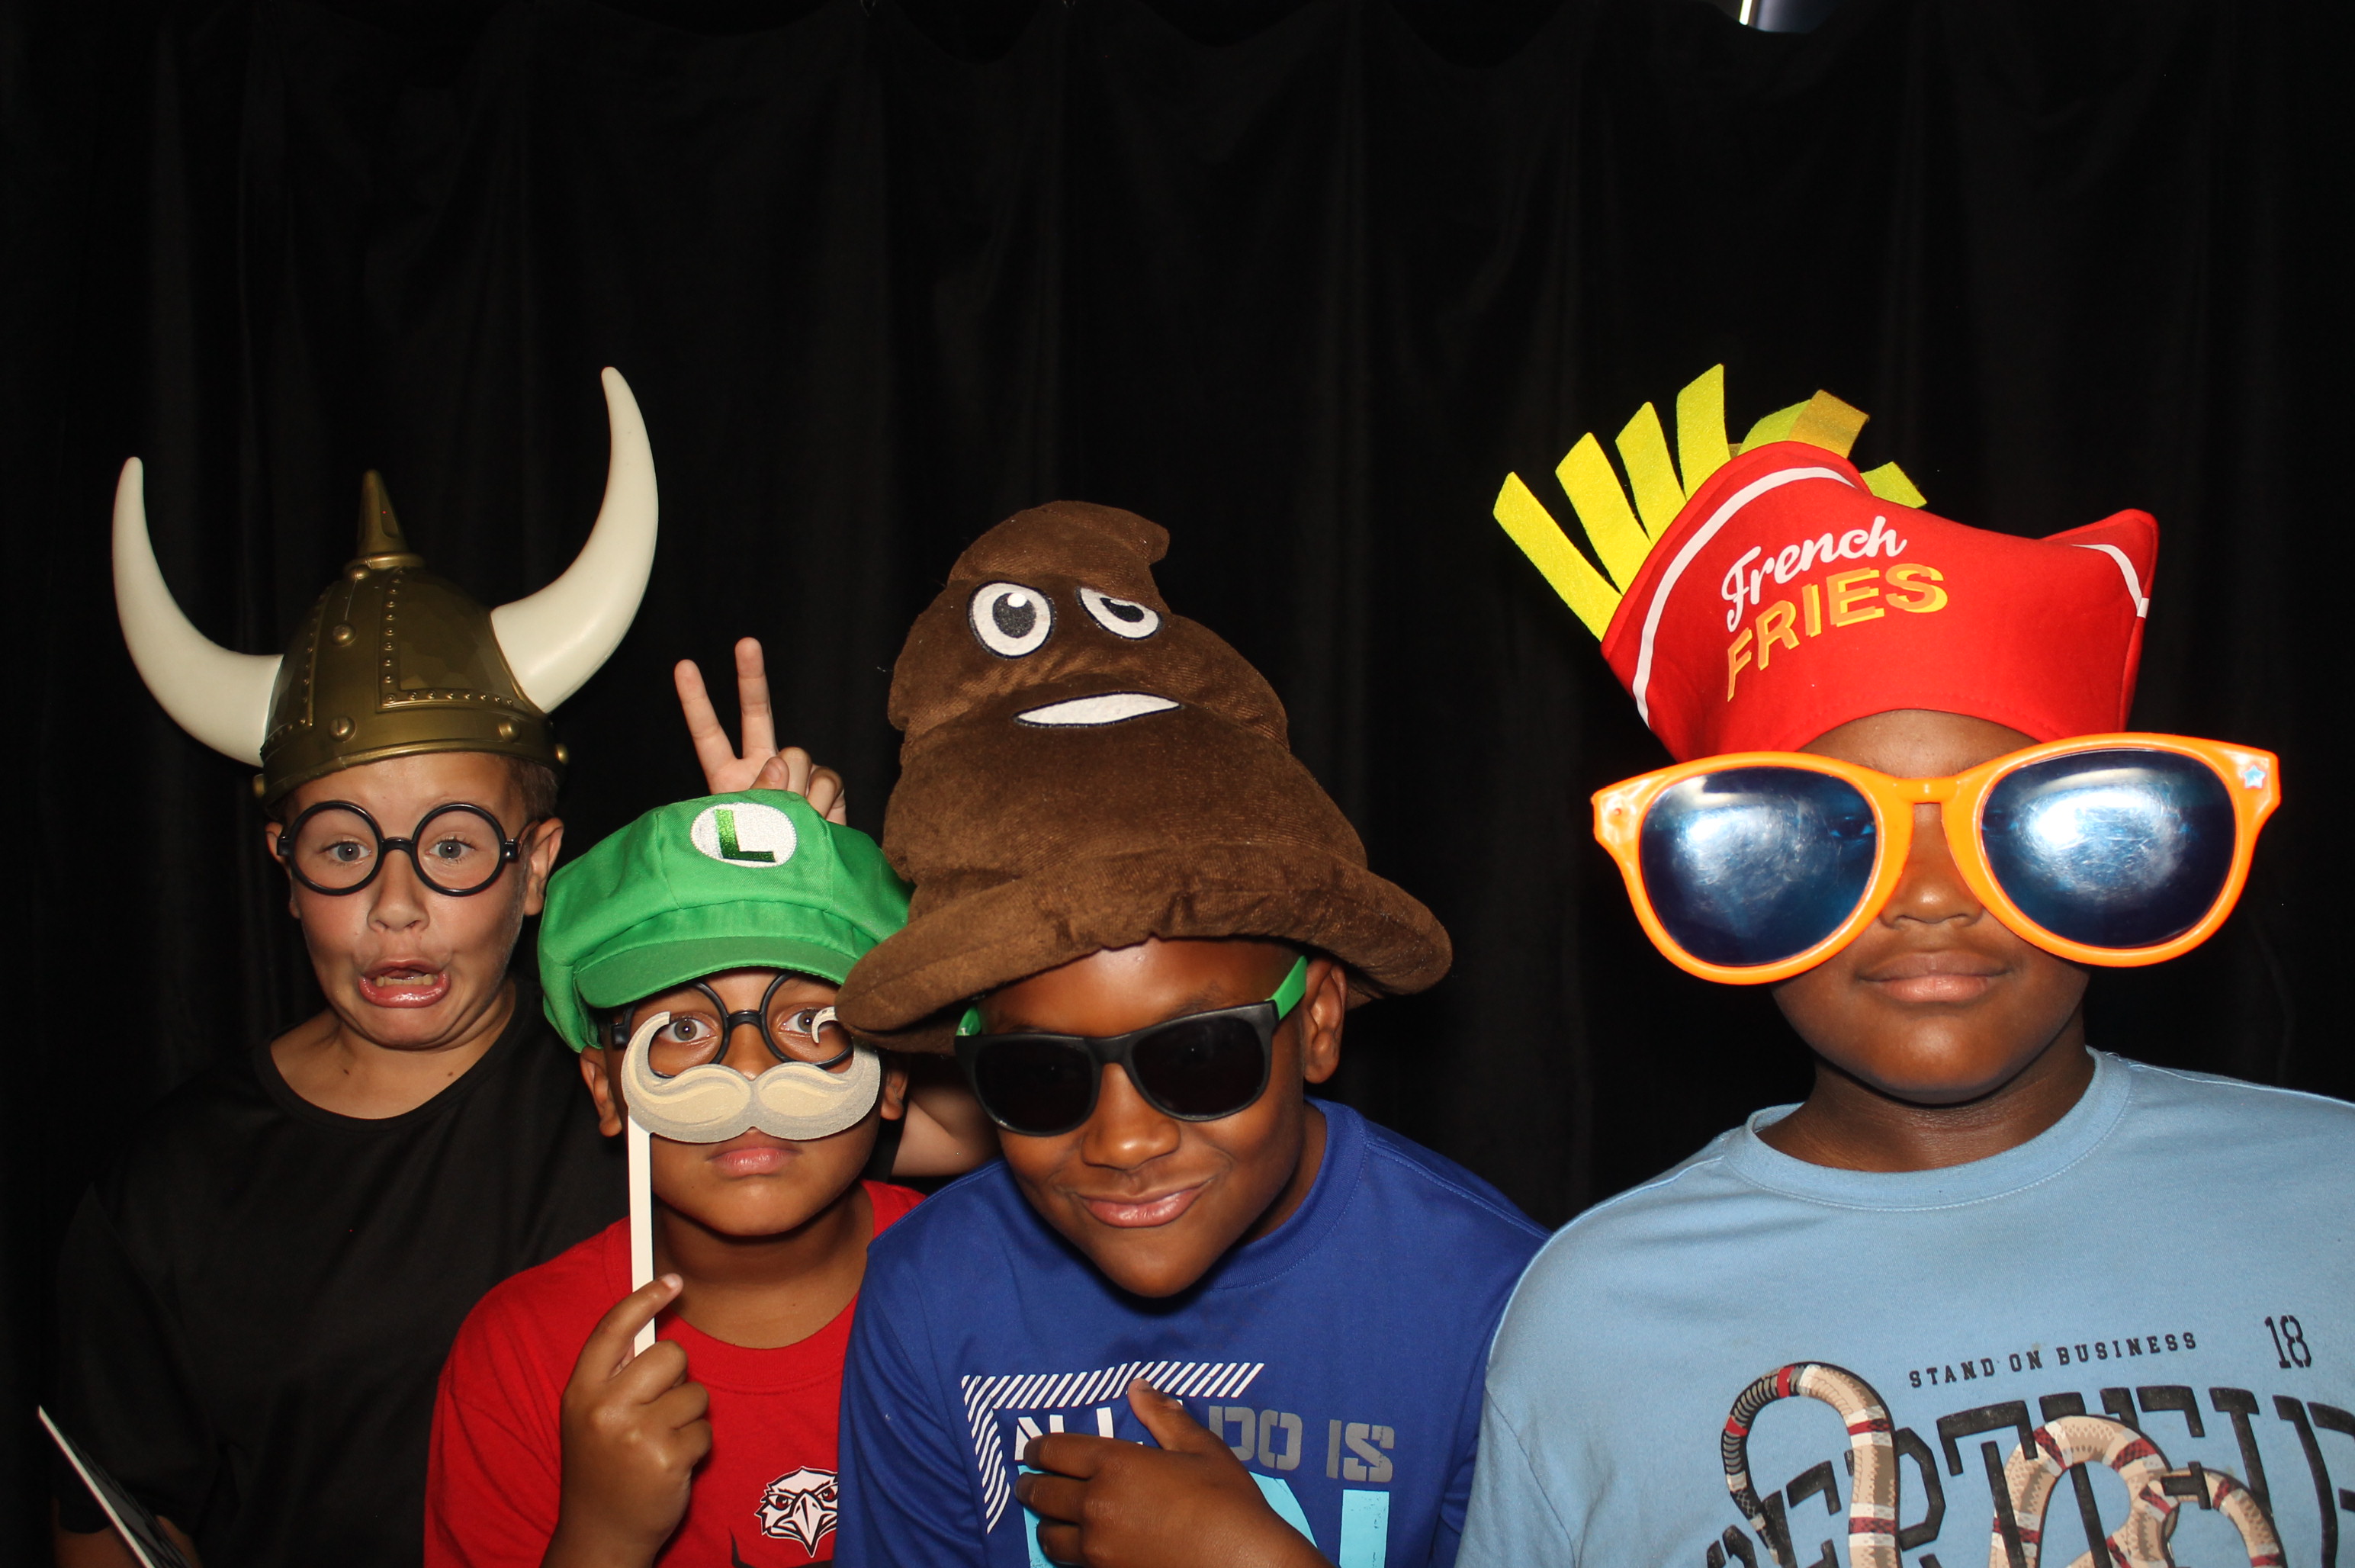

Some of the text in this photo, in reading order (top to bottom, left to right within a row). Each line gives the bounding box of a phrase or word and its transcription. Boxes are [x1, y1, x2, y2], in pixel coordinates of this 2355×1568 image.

[1721, 515, 1907, 632] French
[1727, 563, 1948, 702] FRIES
[714, 808, 776, 863] L
[1909, 1332, 2197, 1389] STAND ON BUSINESS
[2265, 1315, 2312, 1369] 18
[1325, 1419, 1395, 1483] IS
